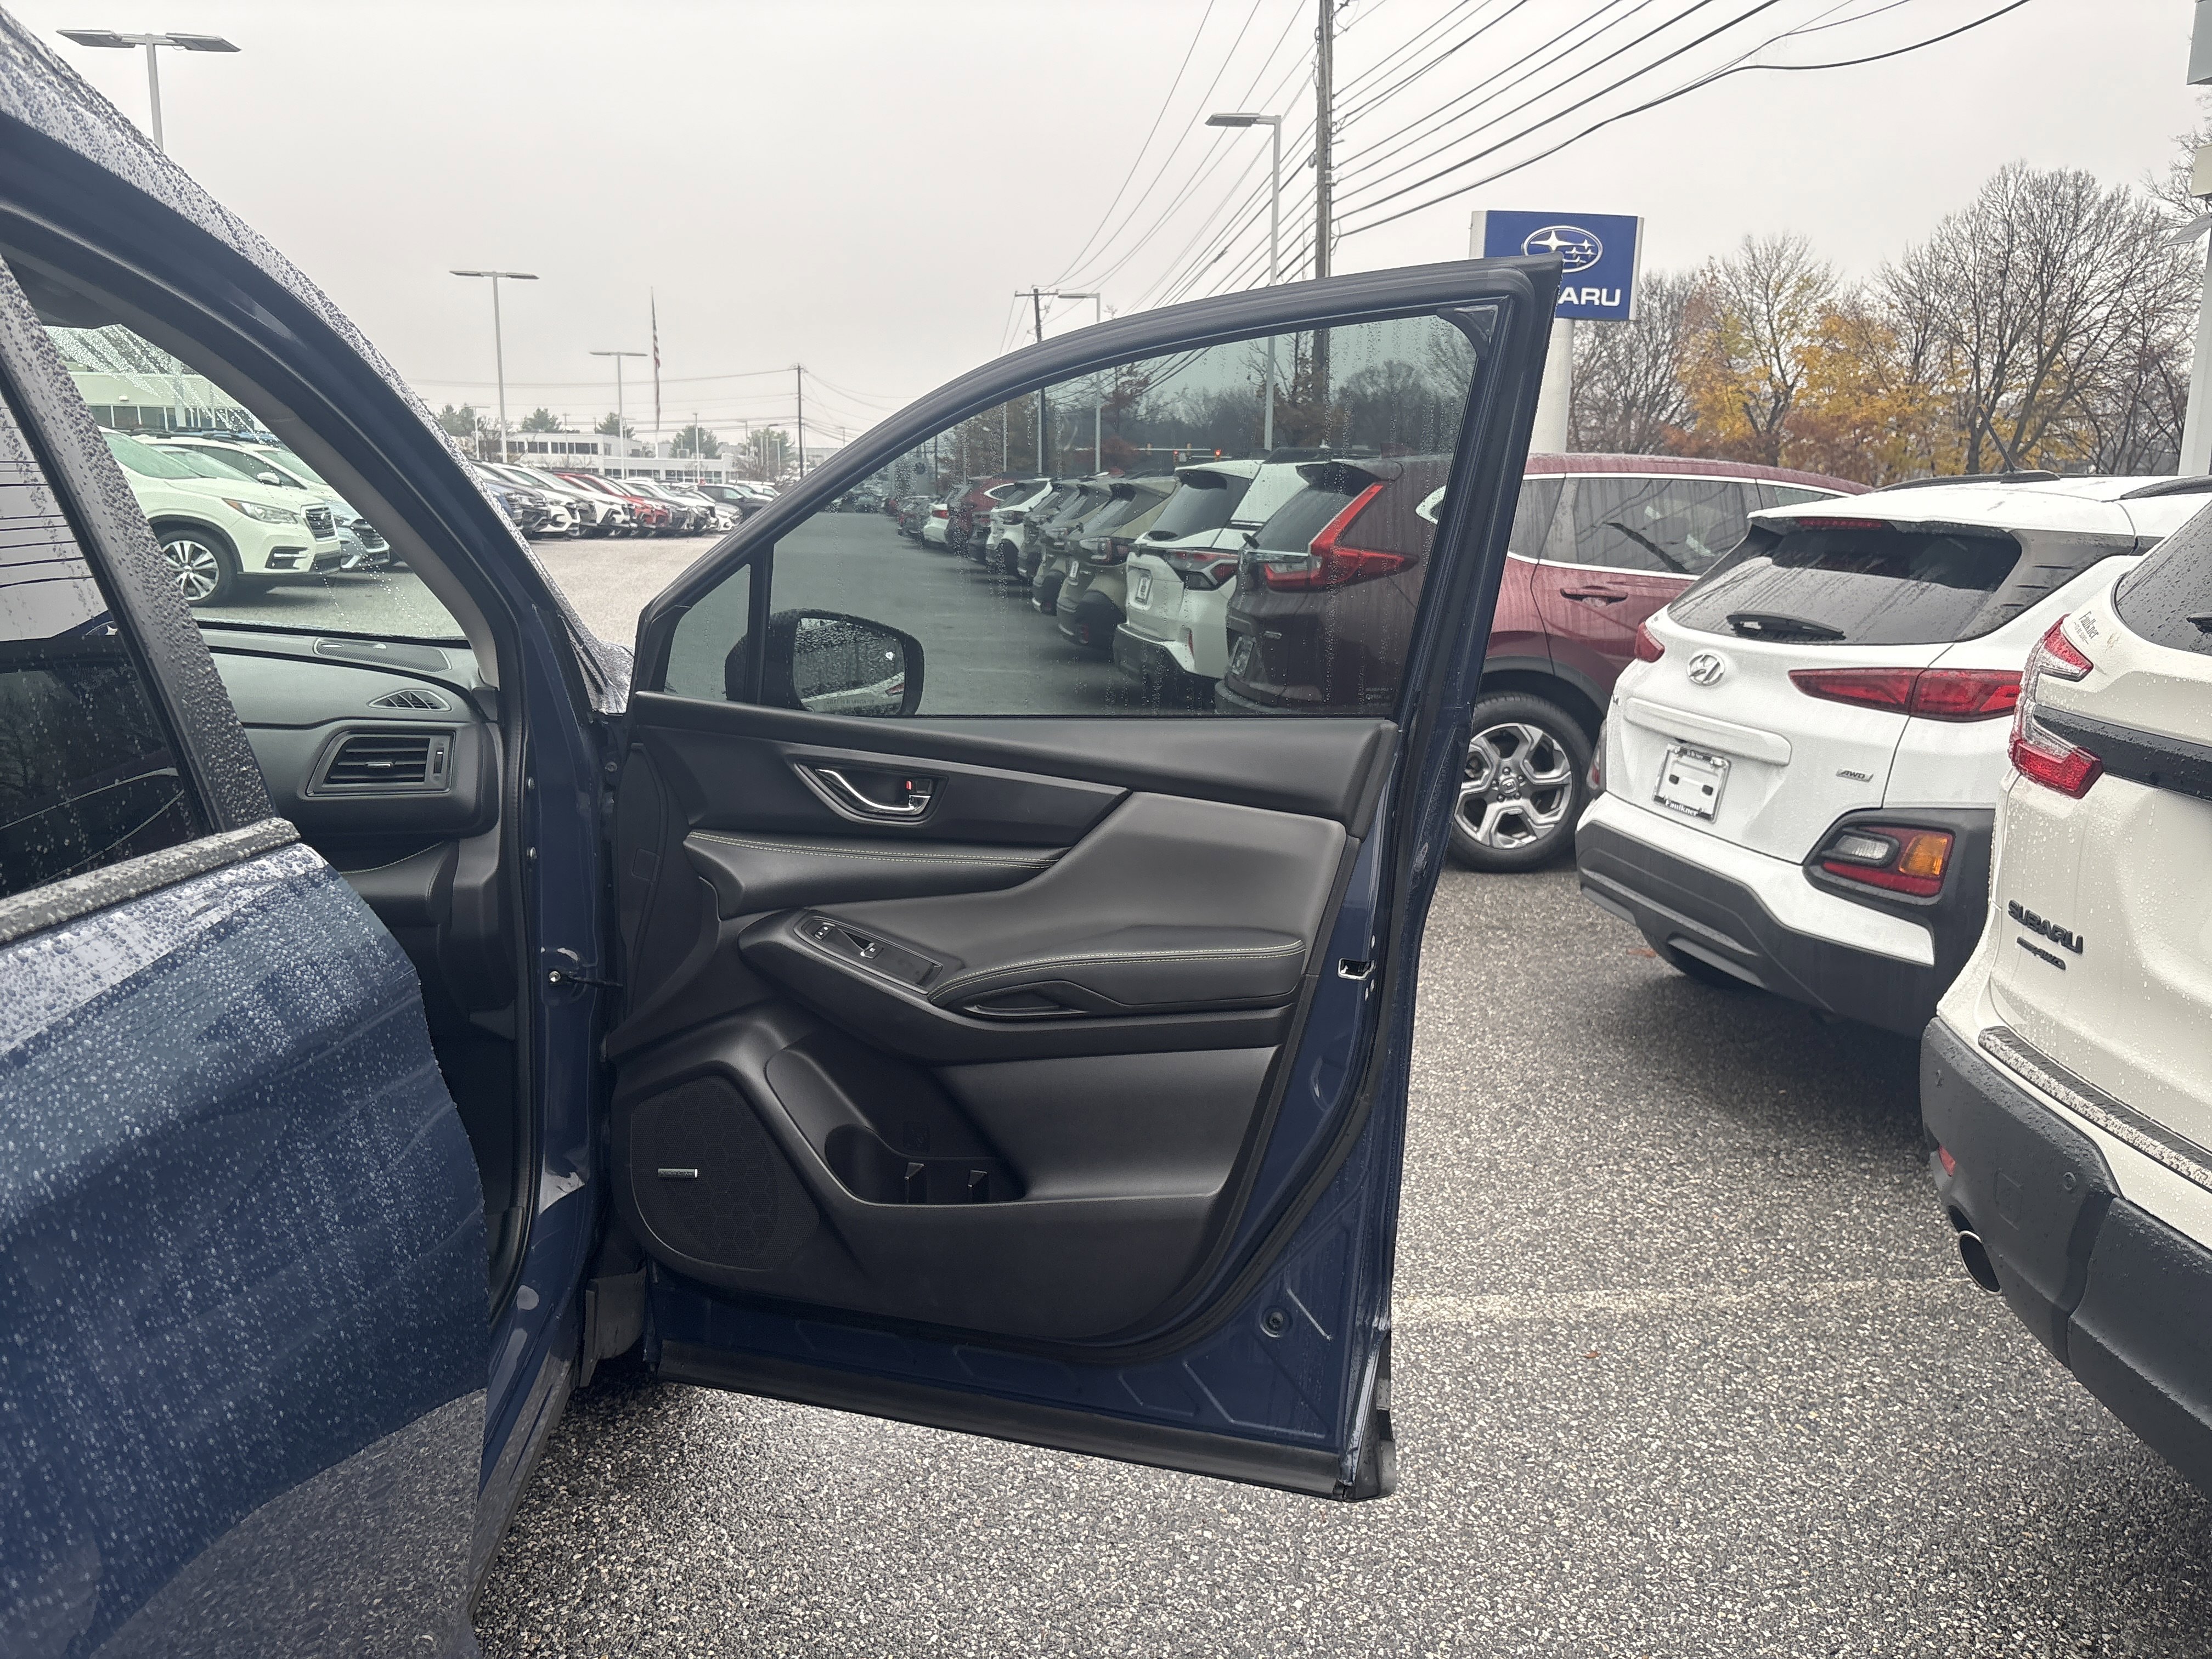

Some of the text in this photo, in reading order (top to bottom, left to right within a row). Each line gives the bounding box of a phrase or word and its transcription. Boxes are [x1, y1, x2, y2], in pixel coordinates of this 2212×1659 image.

[1558, 286, 1622, 307] ARU
[2079, 611, 2099, 639] Faulkner
[1841, 770, 1865, 778] AWD
[1665, 799, 1699, 817] Faulkner
[2008, 899, 2083, 954] SUBARU
